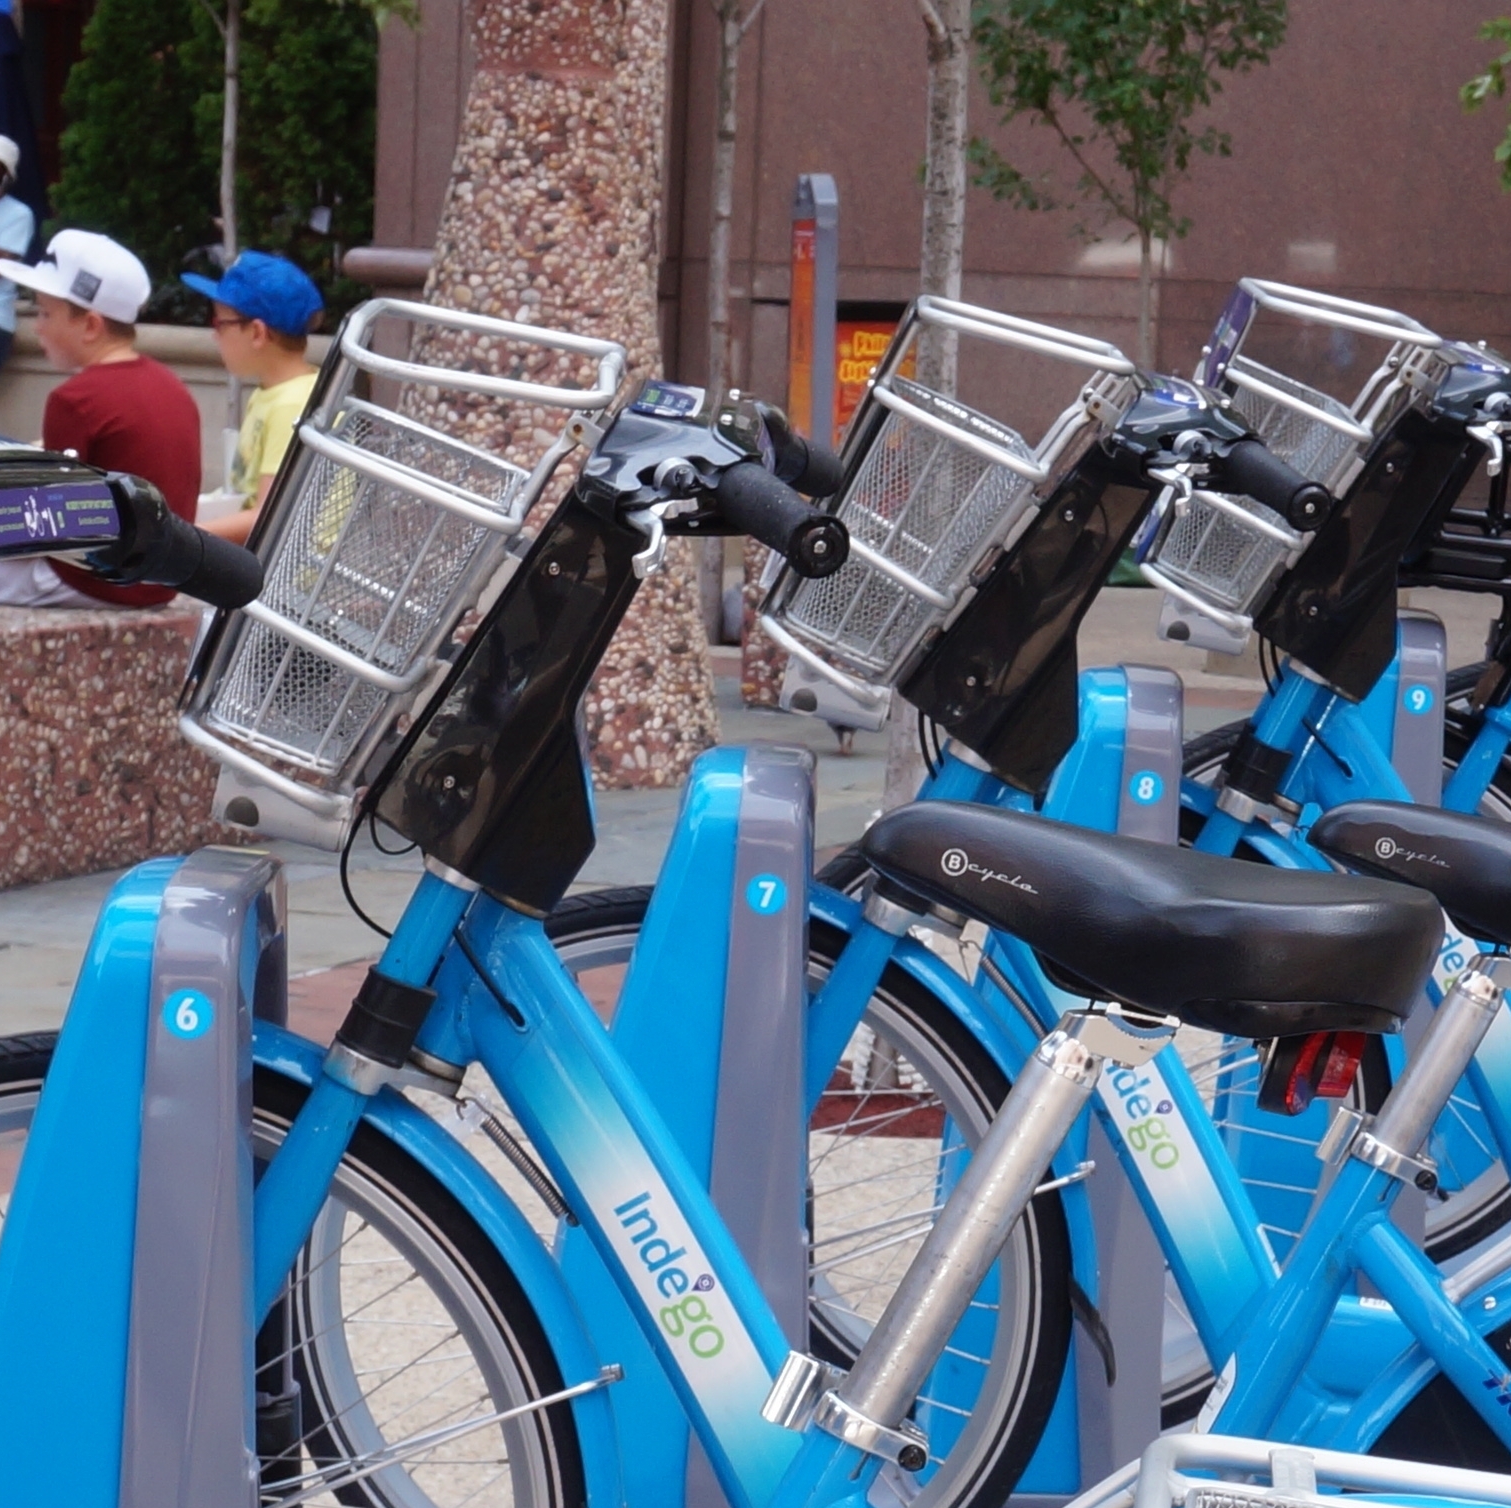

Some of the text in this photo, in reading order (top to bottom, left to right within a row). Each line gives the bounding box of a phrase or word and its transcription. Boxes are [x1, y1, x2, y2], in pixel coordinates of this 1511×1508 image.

[1412, 689, 1426, 711] 9
[1137, 776, 1155, 800] 8
[941, 847, 1039, 895] Bcycle
[758, 881, 777, 908] 7
[176, 997, 199, 1031] 6
[613, 1190, 725, 1359] Indego
